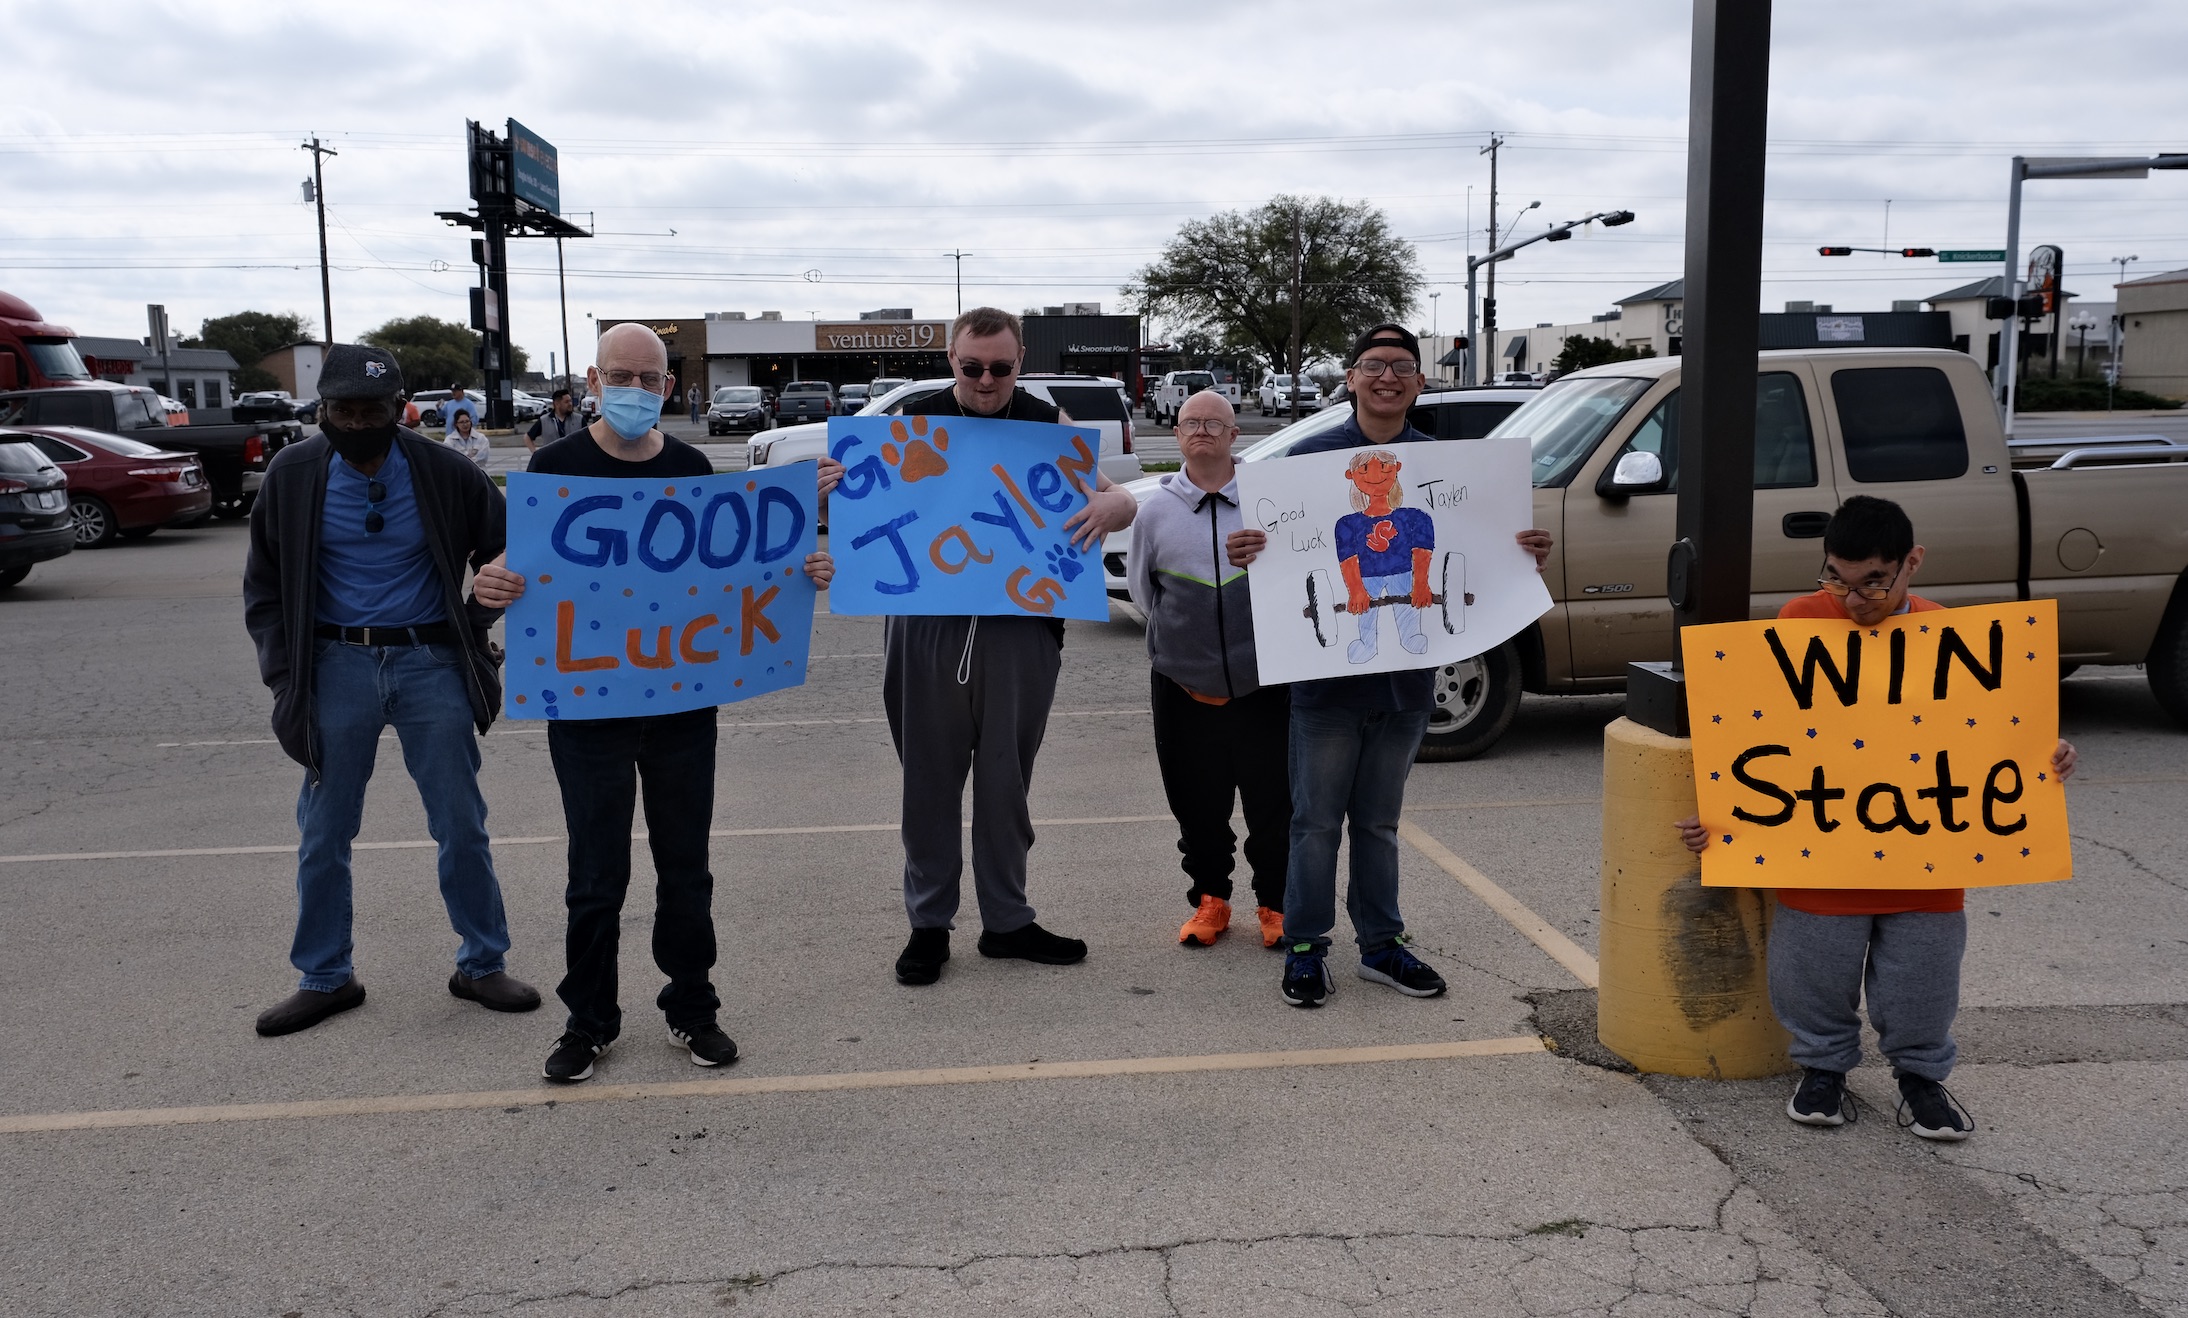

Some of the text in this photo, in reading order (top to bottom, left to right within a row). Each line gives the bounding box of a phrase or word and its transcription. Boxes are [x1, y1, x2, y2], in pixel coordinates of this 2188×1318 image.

[828, 325, 934, 348] venture 19
[1417, 479, 1468, 510] Jaylen
[551, 486, 806, 573] GOOD
[1256, 497, 1305, 535] Good
[1601, 584, 1633, 593] 1500
[1764, 620, 2004, 710] WIN
[1731, 744, 2027, 835] State
